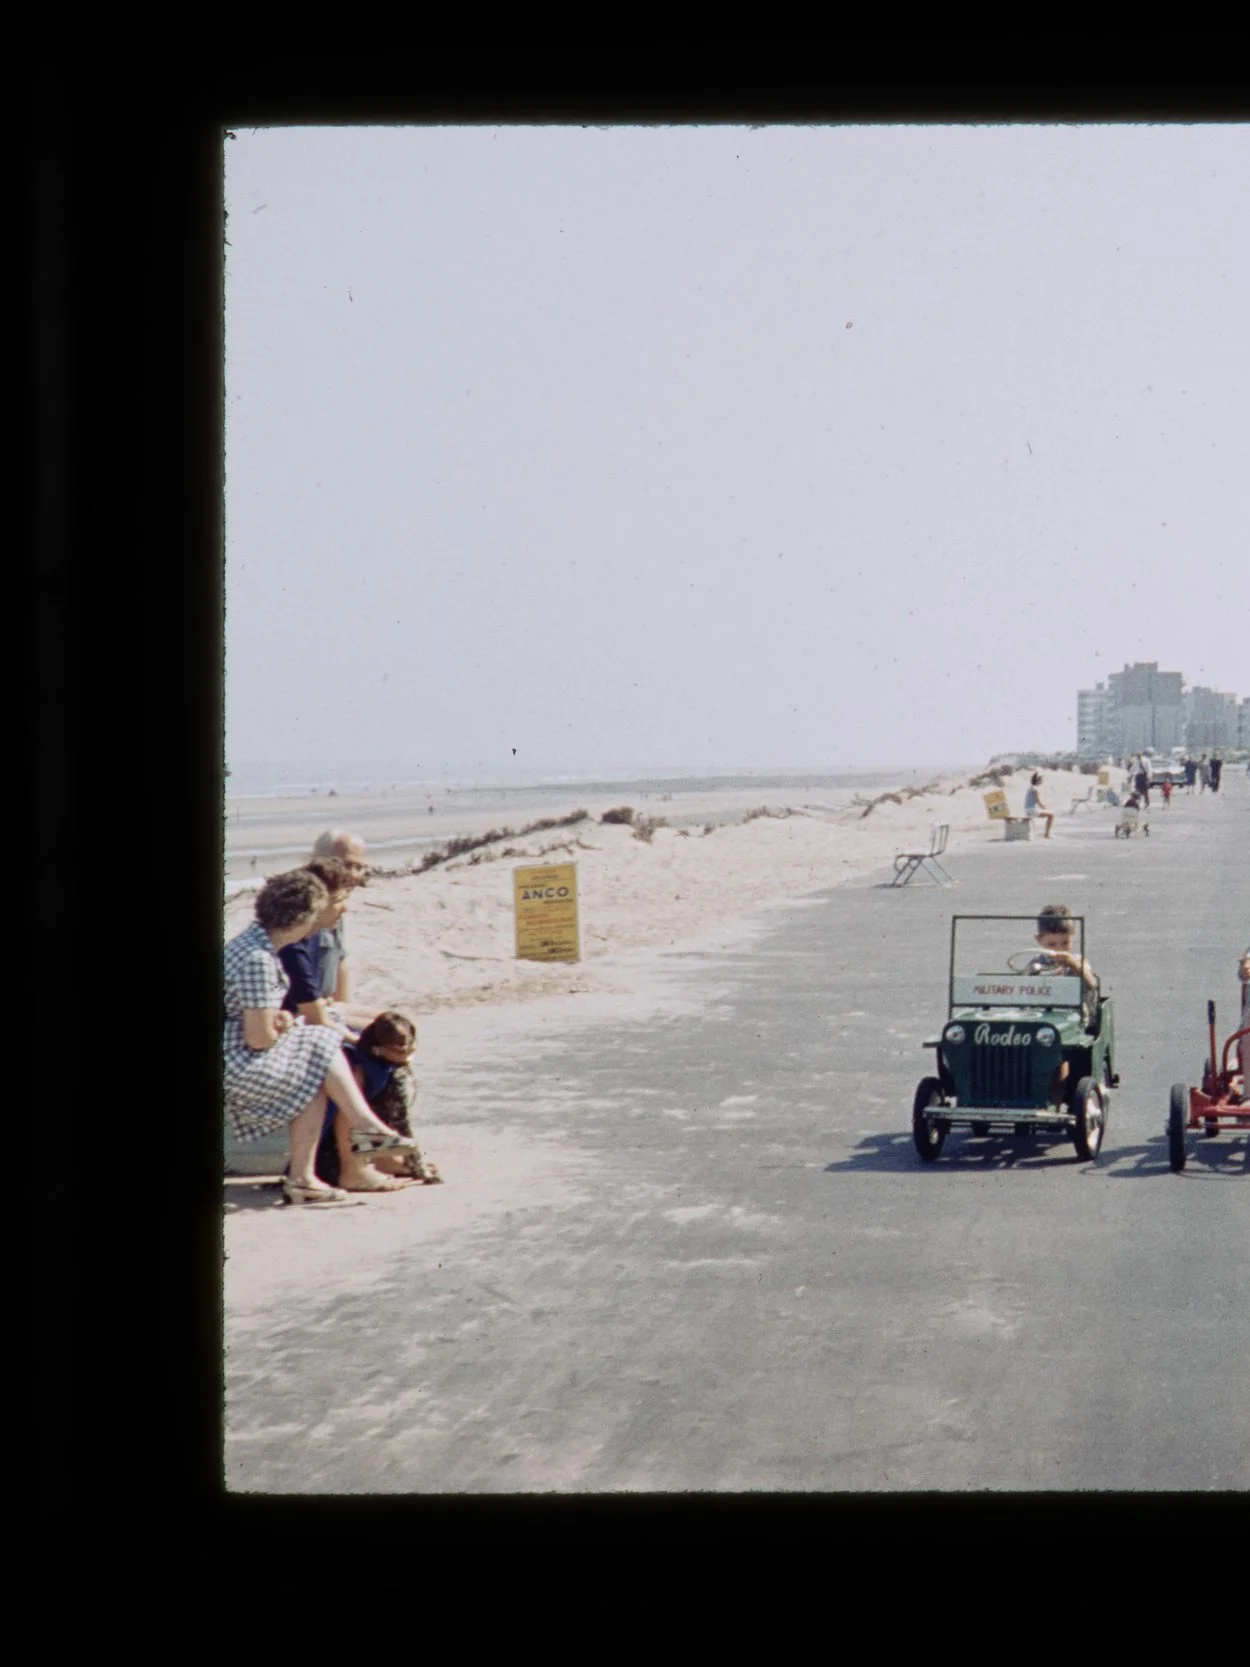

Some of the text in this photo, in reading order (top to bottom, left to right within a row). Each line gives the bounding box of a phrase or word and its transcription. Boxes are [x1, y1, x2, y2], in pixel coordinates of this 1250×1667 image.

[522, 886, 570, 900] ANCO
[973, 985, 1053, 996] MILITARY POLICE
[974, 1022, 1032, 1047] Rodeo
